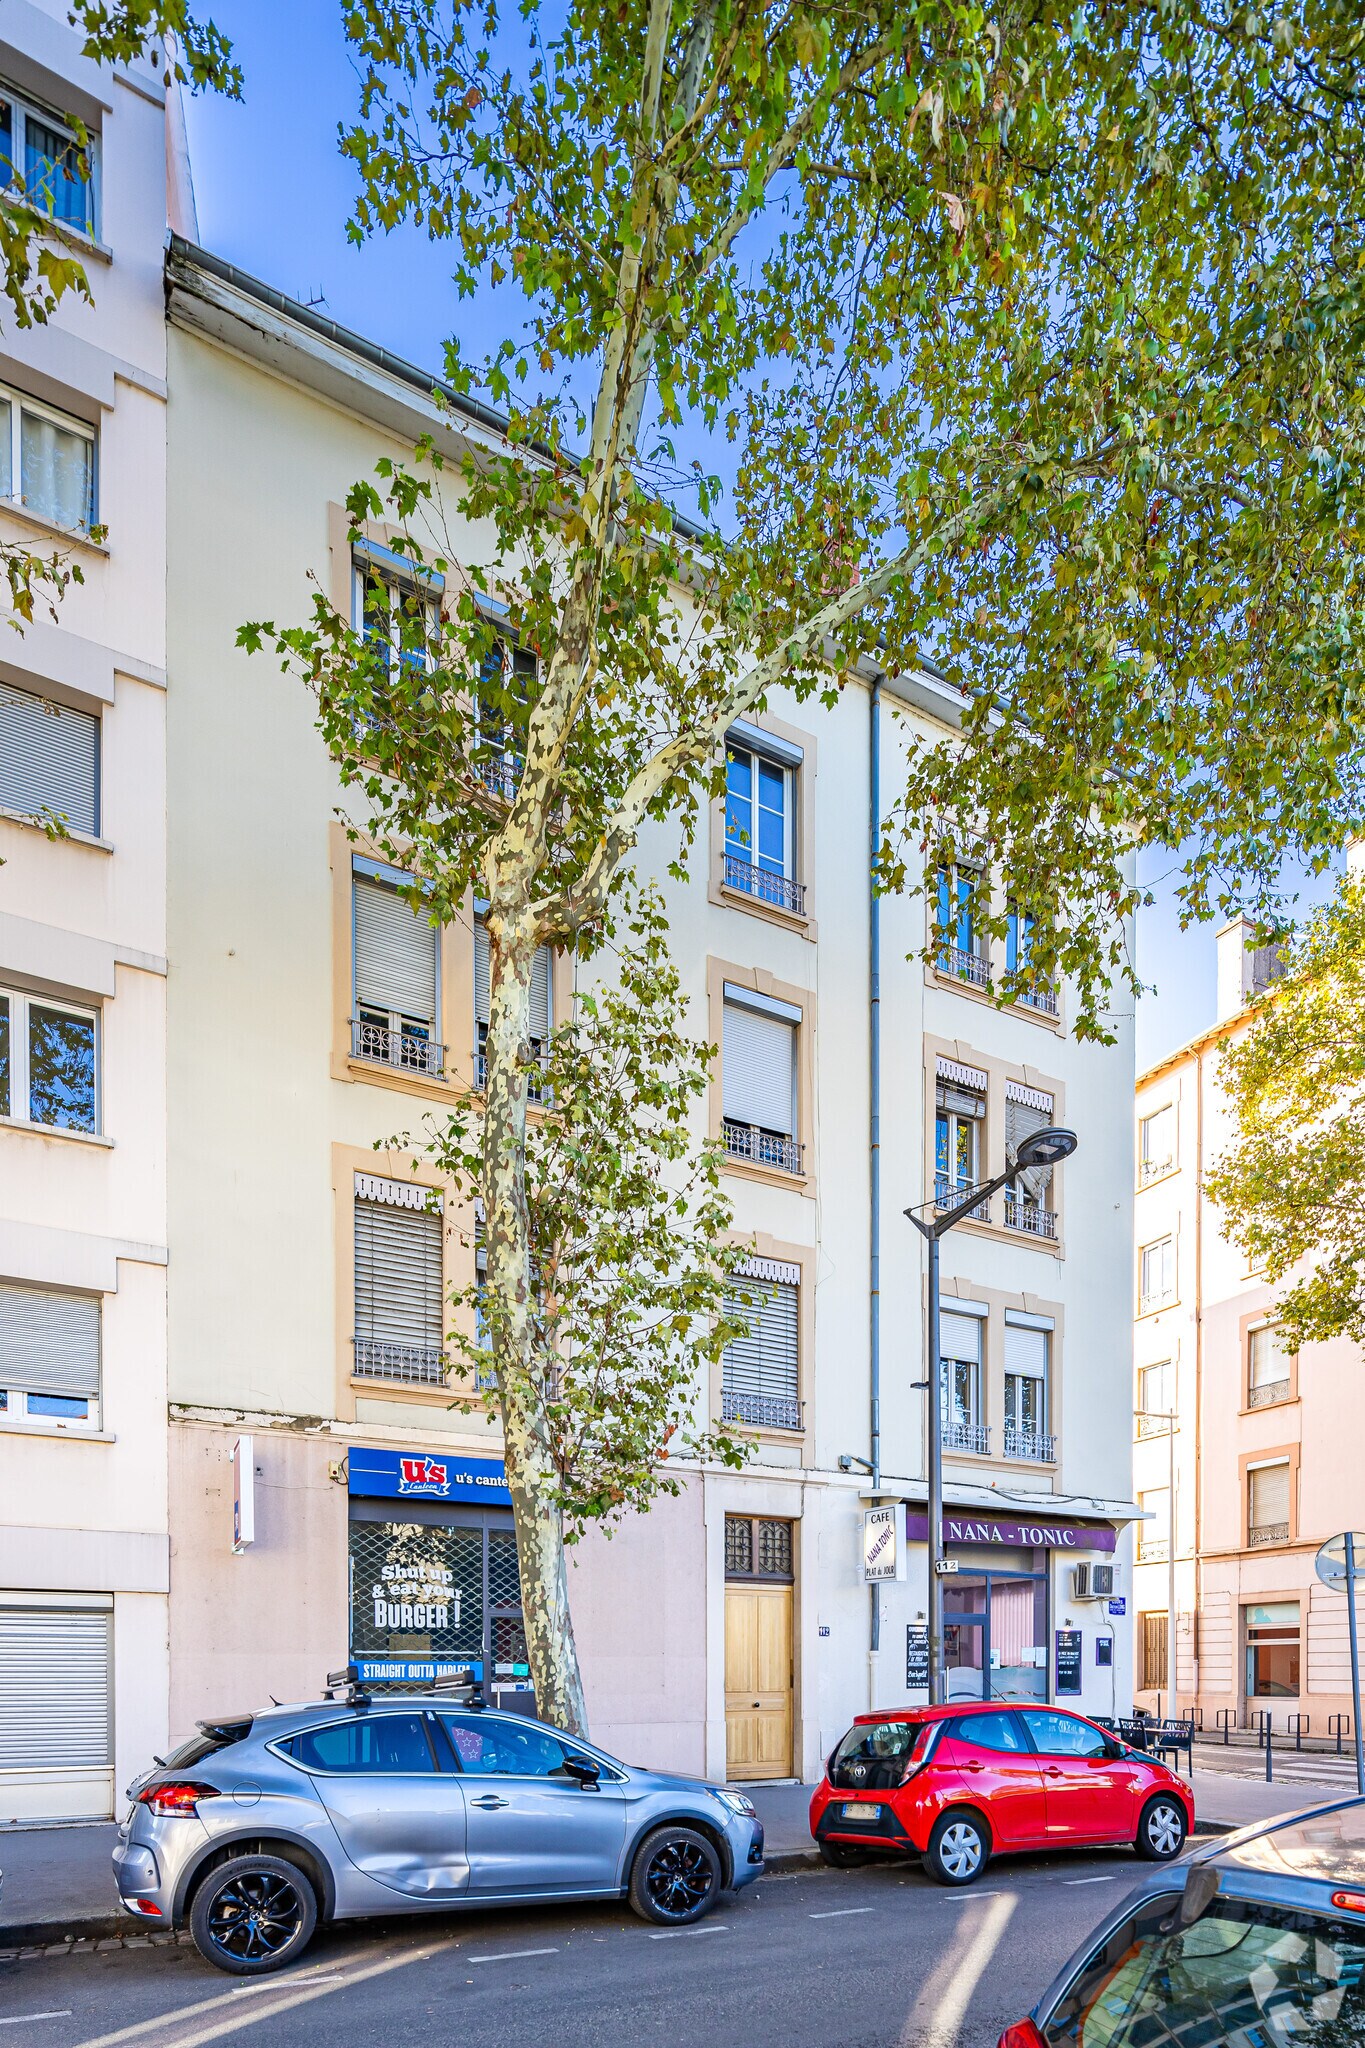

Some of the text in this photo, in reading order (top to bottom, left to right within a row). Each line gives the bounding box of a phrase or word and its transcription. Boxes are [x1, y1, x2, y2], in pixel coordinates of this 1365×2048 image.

[456, 1472, 473, 1484] u's
[870, 1511, 890, 1525] CAFE
[948, 1521, 1004, 1542] NANA
[1017, 1526, 1076, 1546] TONIC
[866, 1524, 894, 1565] NANA TONIC
[381, 1563, 453, 1585] Shut up
[936, 1561, 956, 1571] 112
[372, 1581, 463, 1600] & eat your
[374, 1599, 448, 1629] BURGER
[363, 1663, 406, 1678] STRAIGHT
[407, 1664, 435, 1678] OUTTA
